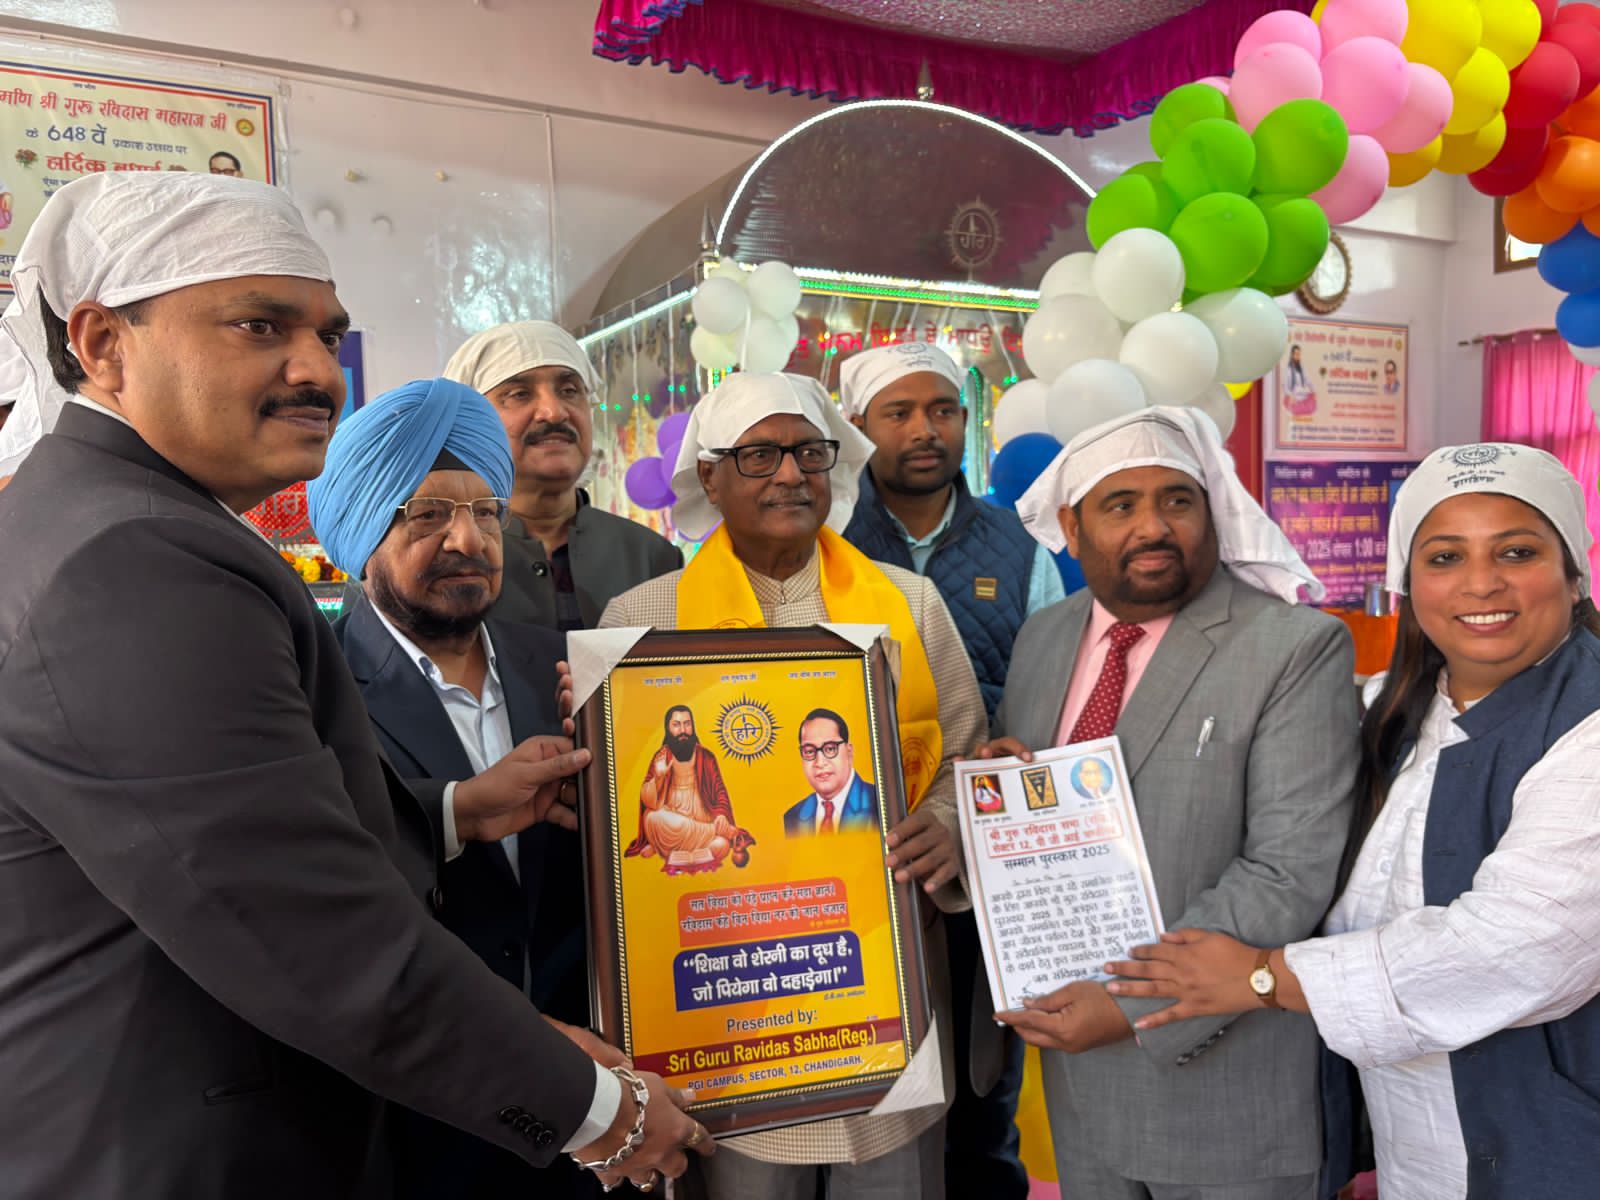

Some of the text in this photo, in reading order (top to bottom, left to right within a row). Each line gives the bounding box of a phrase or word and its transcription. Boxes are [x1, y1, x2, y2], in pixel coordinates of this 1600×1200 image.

[40, 92, 58, 110] श्री
[99, 99, 149, 121] रविदास
[155, 108, 205, 128] महाराज
[210, 112, 228, 131] जी
[25, 127, 39, 138] के
[48, 125, 86, 141] 648
[91, 123, 107, 145] वें
[175, 145, 188, 155] पर
[1003, 844, 1111, 871] सम्मान पुरस्कार 2025
[732, 949, 748, 973] वो
[750, 943, 788, 968] शेरनी
[790, 943, 810, 963] का
[812, 942, 834, 965] दूध
[691, 979, 714, 1003] जो
[716, 975, 760, 1000] पियेगा
[762, 971, 778, 993] वो
[727, 1008, 819, 1033] Presented by:
[669, 1026, 877, 1073] Sri Guru Ravidas Sabha(Reg.)
[688, 1055, 863, 1090] PGI CAMPUS, SECTOR, 12, CHANDIGARH.
